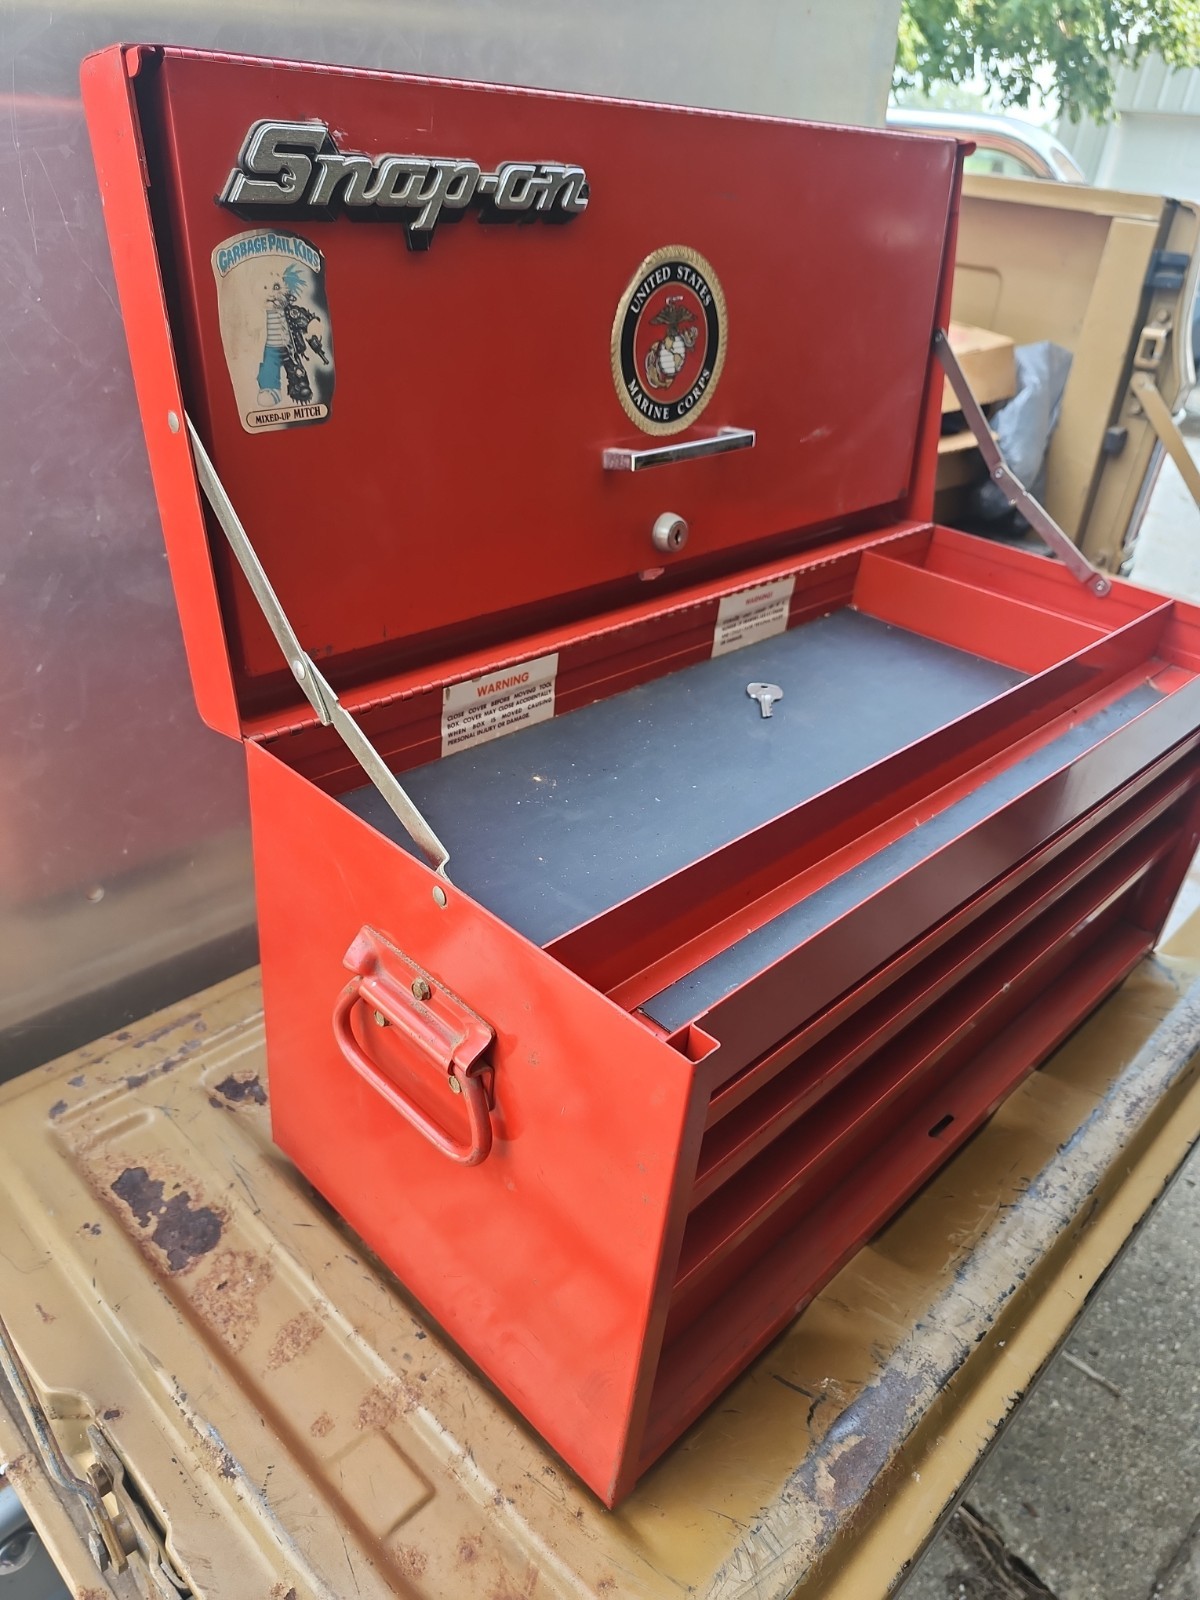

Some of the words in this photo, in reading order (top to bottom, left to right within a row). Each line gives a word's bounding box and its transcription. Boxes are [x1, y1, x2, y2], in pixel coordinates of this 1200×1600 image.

[219, 119, 590, 231] Snap-on
[218, 236, 267, 273] GARBAGE
[267, 233, 293, 255] PAIL
[293, 238, 320, 268] KIDS
[630, 266, 671, 314] UNITED
[676, 265, 712, 307] STATES
[627, 378, 670, 420] MARINE
[677, 369, 711, 416] CORPS
[255, 411, 290, 424] MIXED-UP
[293, 406, 321, 419] MITCH
[447, 710, 465, 722] CLOSE
[468, 703, 487, 714] COVER
[490, 695, 510, 707] BEFORE
[513, 686, 537, 699] MOVING
[539, 681, 552, 690] TOOL
[476, 671, 530, 697] WARNING
[447, 727, 467, 738] WHEN
[472, 720, 485, 730] BOX
[501, 707, 523, 719] MOVED
[527, 697, 552, 710] CAUSING
[462, 713, 482, 724] COVER
[484, 707, 497, 717] MAY
[498, 702, 514, 712] CLOSE
[515, 689, 552, 706] ACCIDENTALLY
[447, 732, 476, 746] PERSONAL
[476, 725, 496, 736] INJURY
[497, 720, 506, 729] OR
